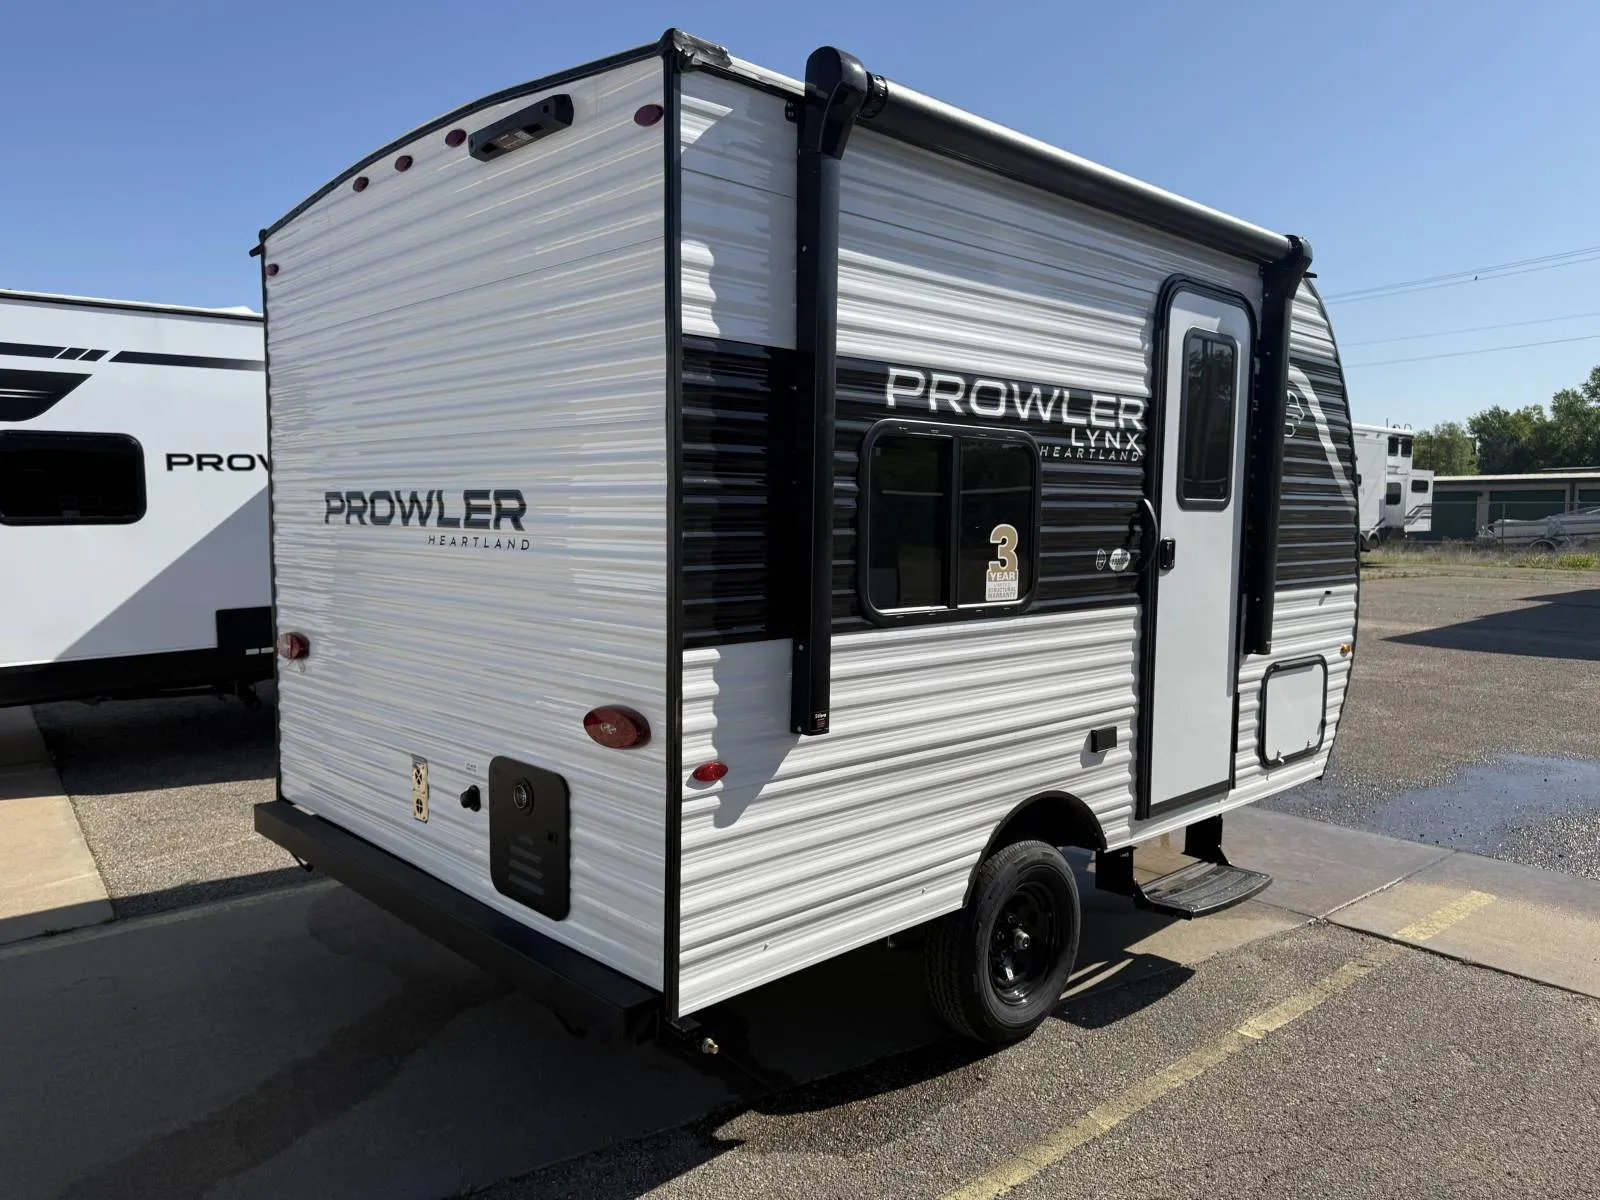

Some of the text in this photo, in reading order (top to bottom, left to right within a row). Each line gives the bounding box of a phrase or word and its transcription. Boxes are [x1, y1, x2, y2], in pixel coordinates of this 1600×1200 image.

[886, 367, 1147, 430] PROWLER
[1039, 445, 1140, 462] HEARTLAND
[1071, 427, 1143, 455] LYNX
[324, 489, 527, 531] PROWLER
[427, 535, 530, 550] HEARTLAND
[989, 524, 1019, 571] 3
[990, 571, 1016, 581] YEAR
